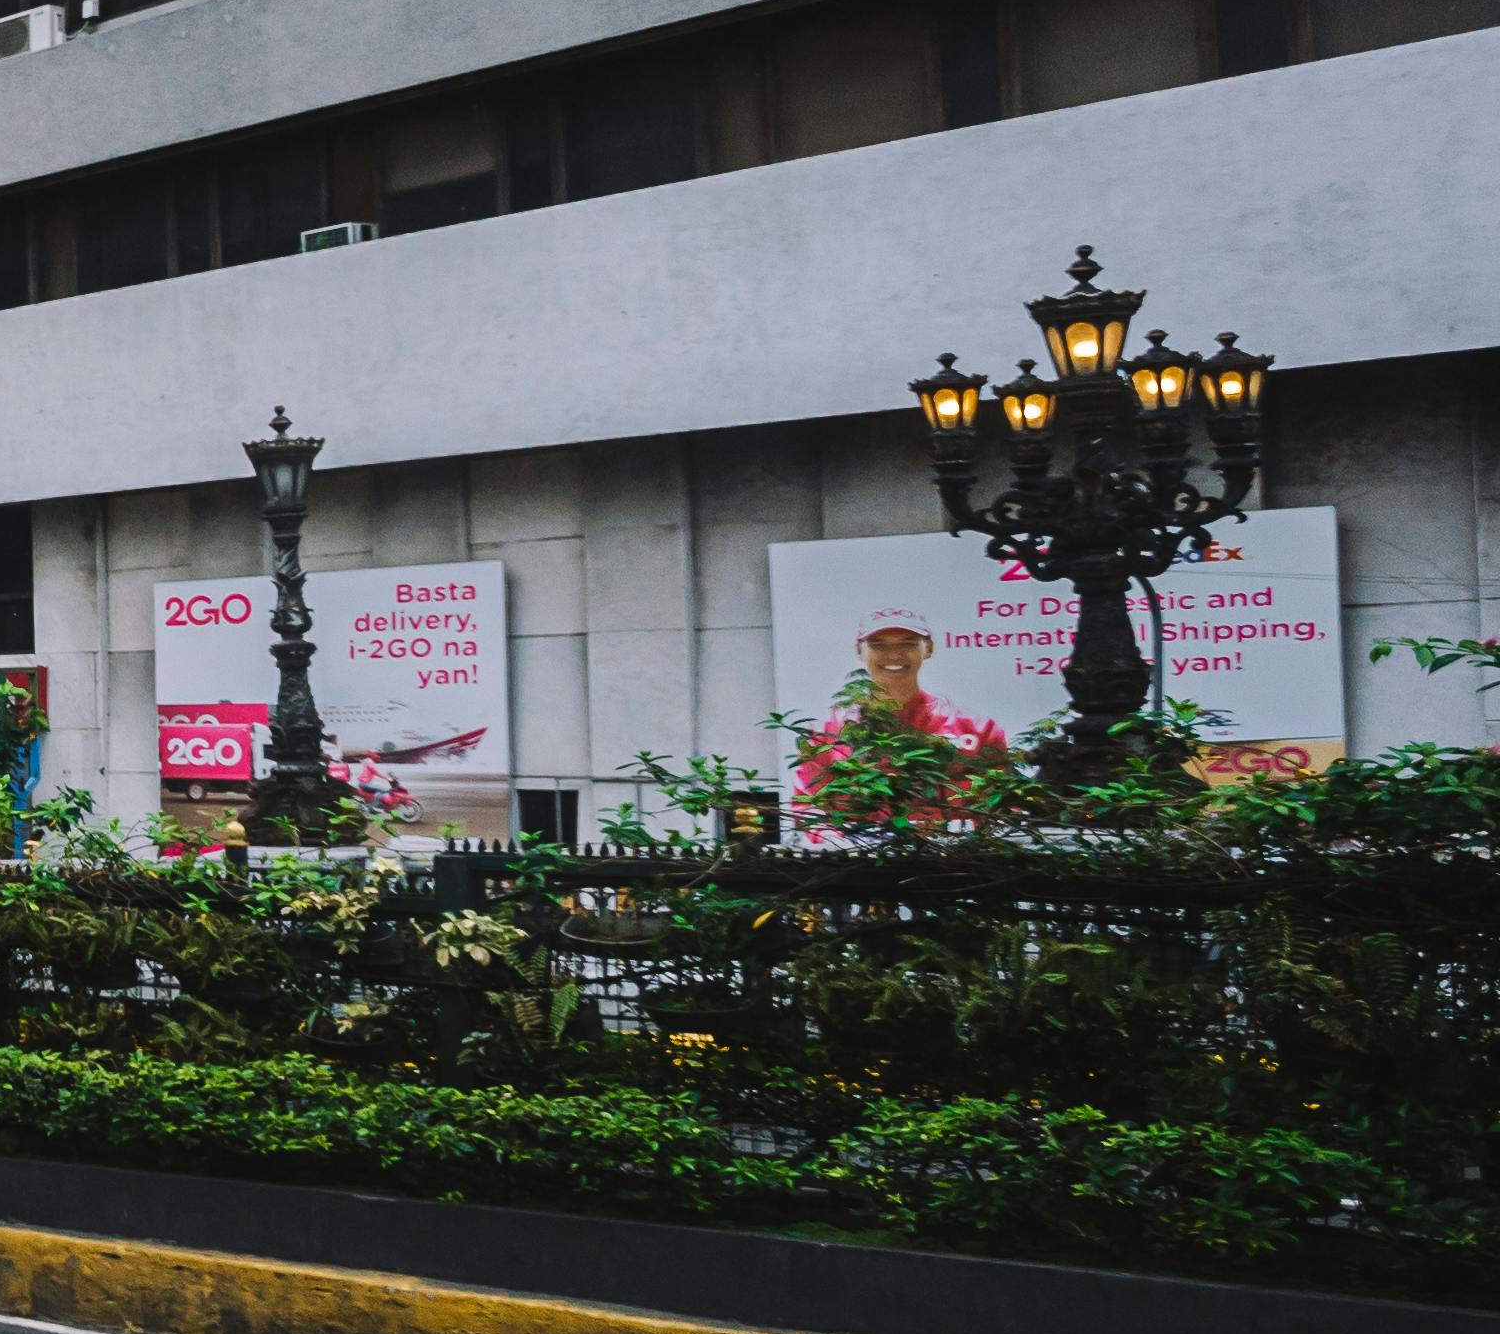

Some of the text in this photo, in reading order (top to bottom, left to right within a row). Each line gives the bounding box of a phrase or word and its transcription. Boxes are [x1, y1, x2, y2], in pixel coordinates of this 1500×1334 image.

[1172, 541, 1245, 563] edEx
[396, 582, 477, 603] Basta
[977, 587, 1273, 618] For Doestic and
[165, 593, 252, 627] 2GO
[355, 612, 477, 633] delivery,
[945, 618, 1326, 649] Internatil Shipping,
[350, 638, 477, 659] i-2GO na
[1015, 652, 1243, 676] i-2 yan!
[418, 665, 478, 689] yan!
[166, 737, 242, 766] 2GO
[1206, 746, 1310, 774] 2GO
